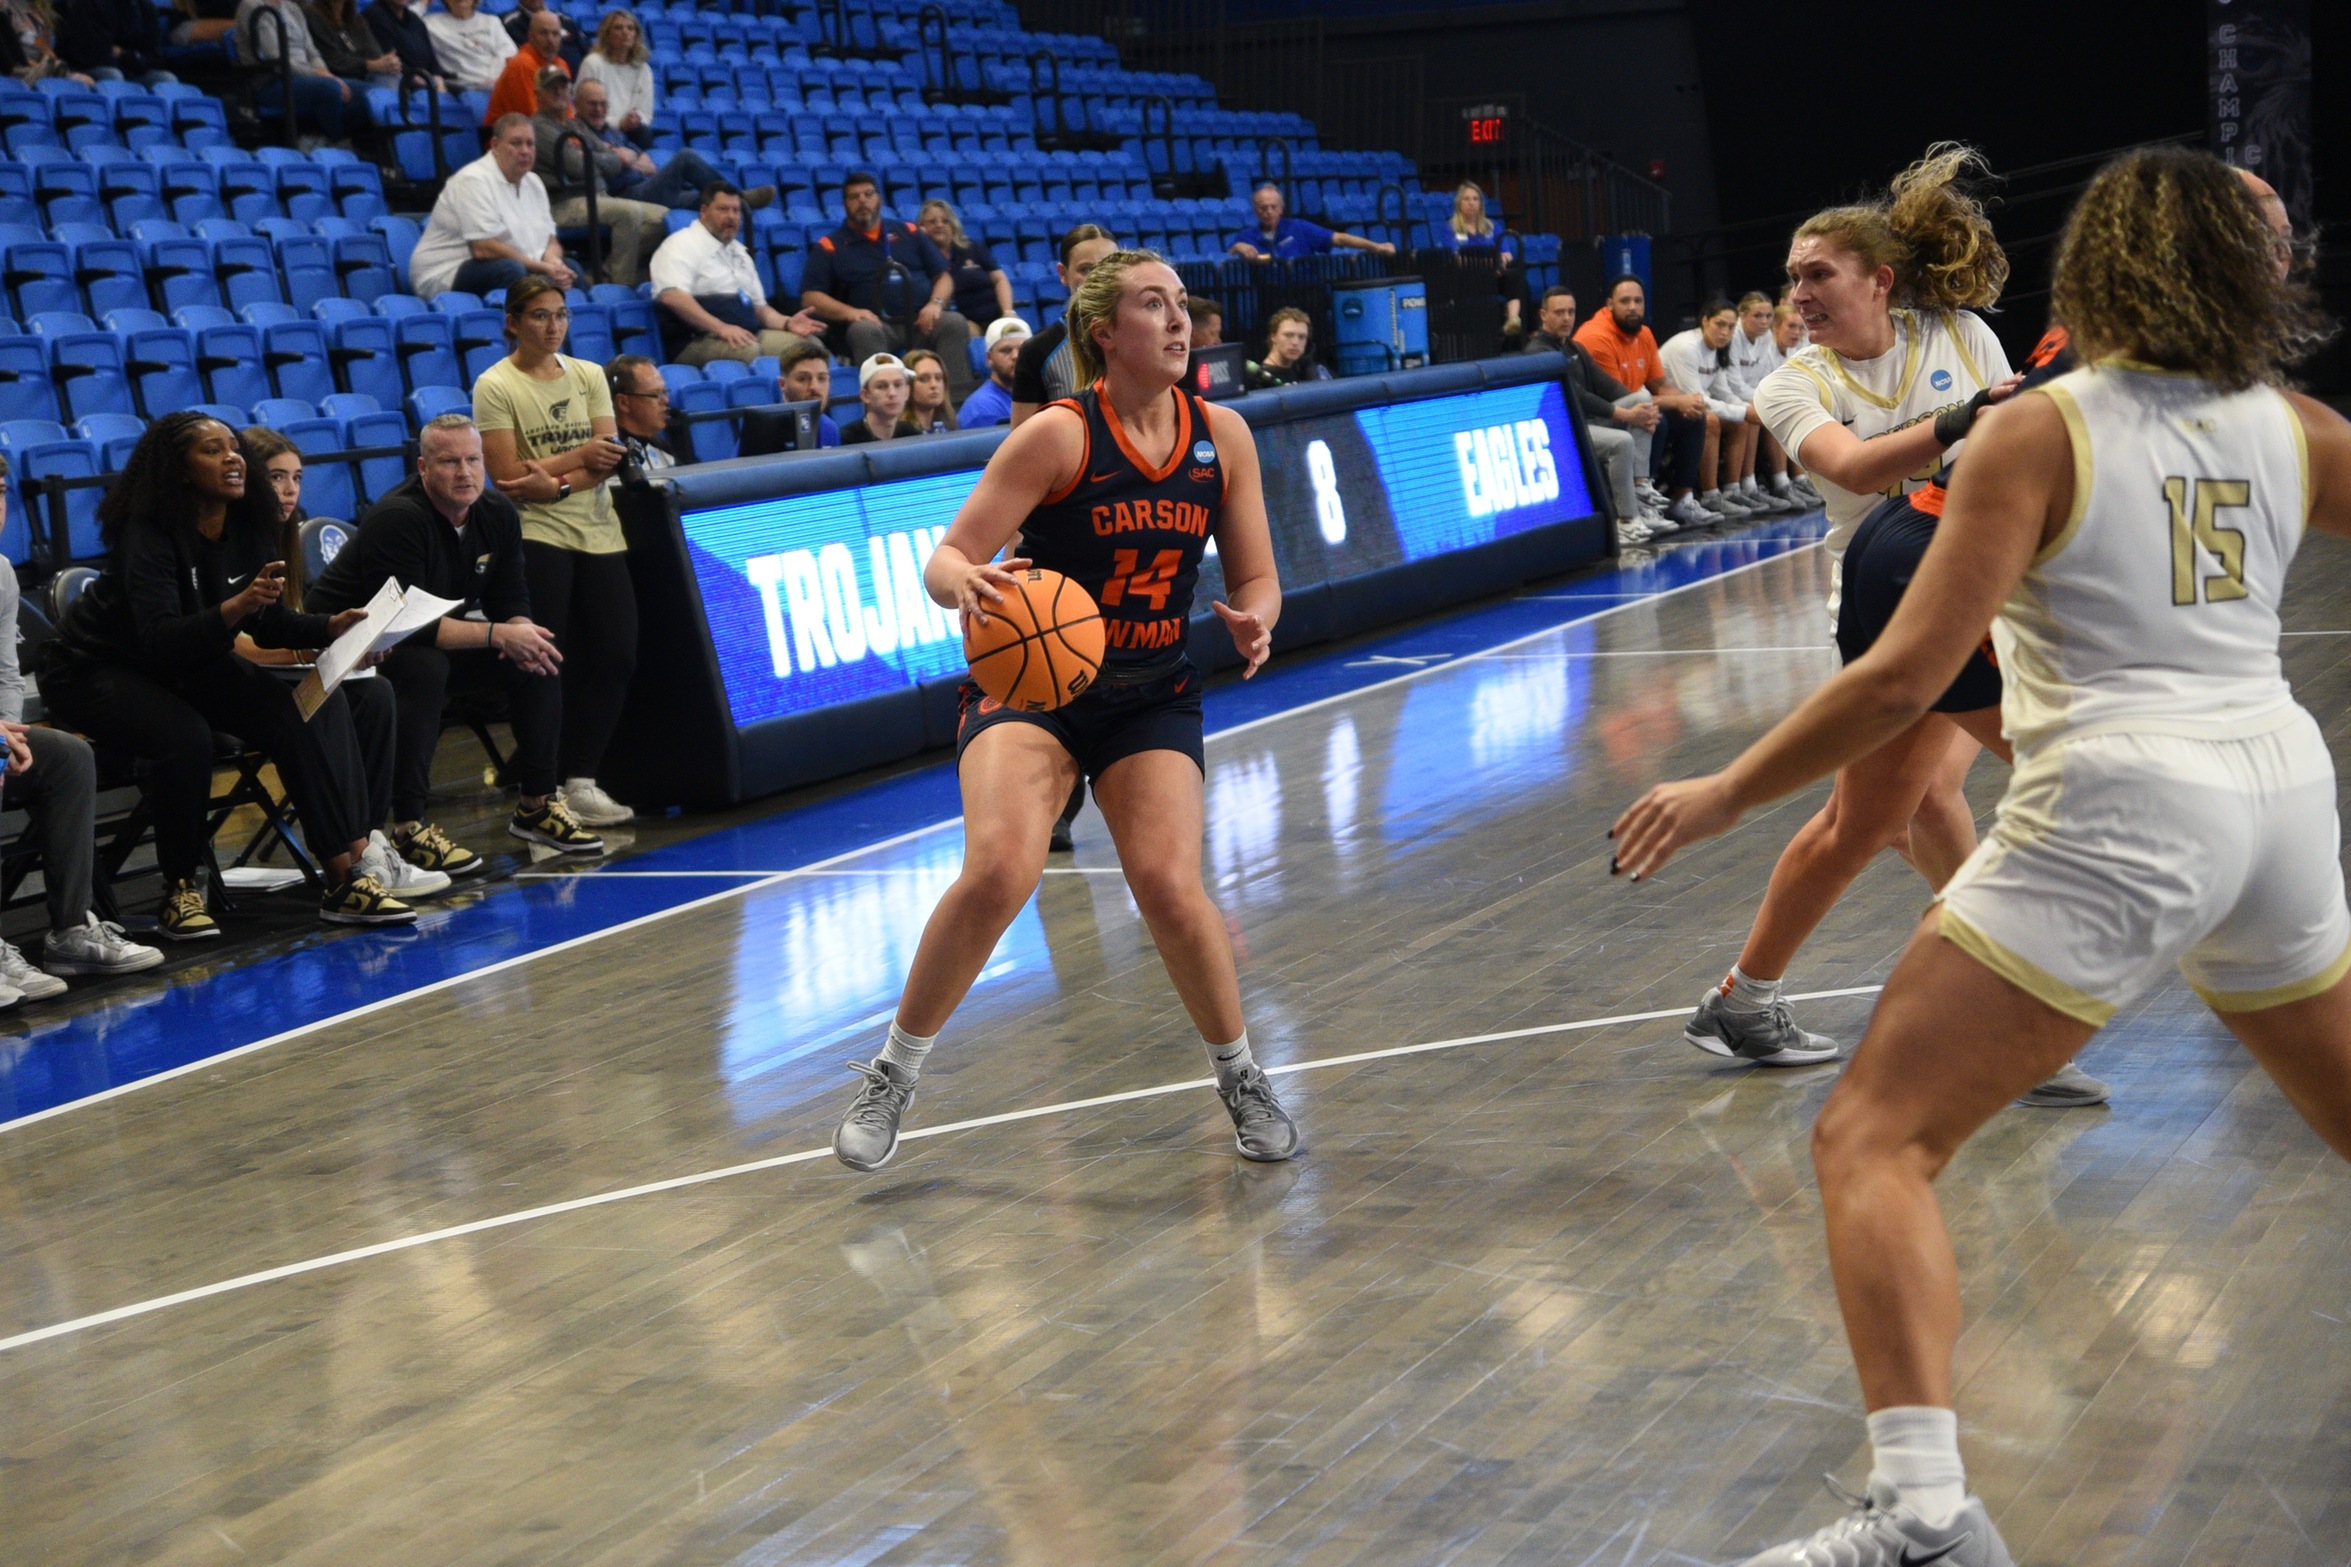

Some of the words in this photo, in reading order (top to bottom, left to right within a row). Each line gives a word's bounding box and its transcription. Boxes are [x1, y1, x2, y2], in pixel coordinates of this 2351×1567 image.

[1191, 466, 1216, 479] SAC
[1195, 450, 1216, 459] NCAA
[1455, 418, 1559, 517] EAGLES
[1091, 499, 1210, 538] CARSON
[1306, 439, 1347, 546] 8
[2162, 475, 2251, 607] 15
[1100, 548, 1184, 611] 14
